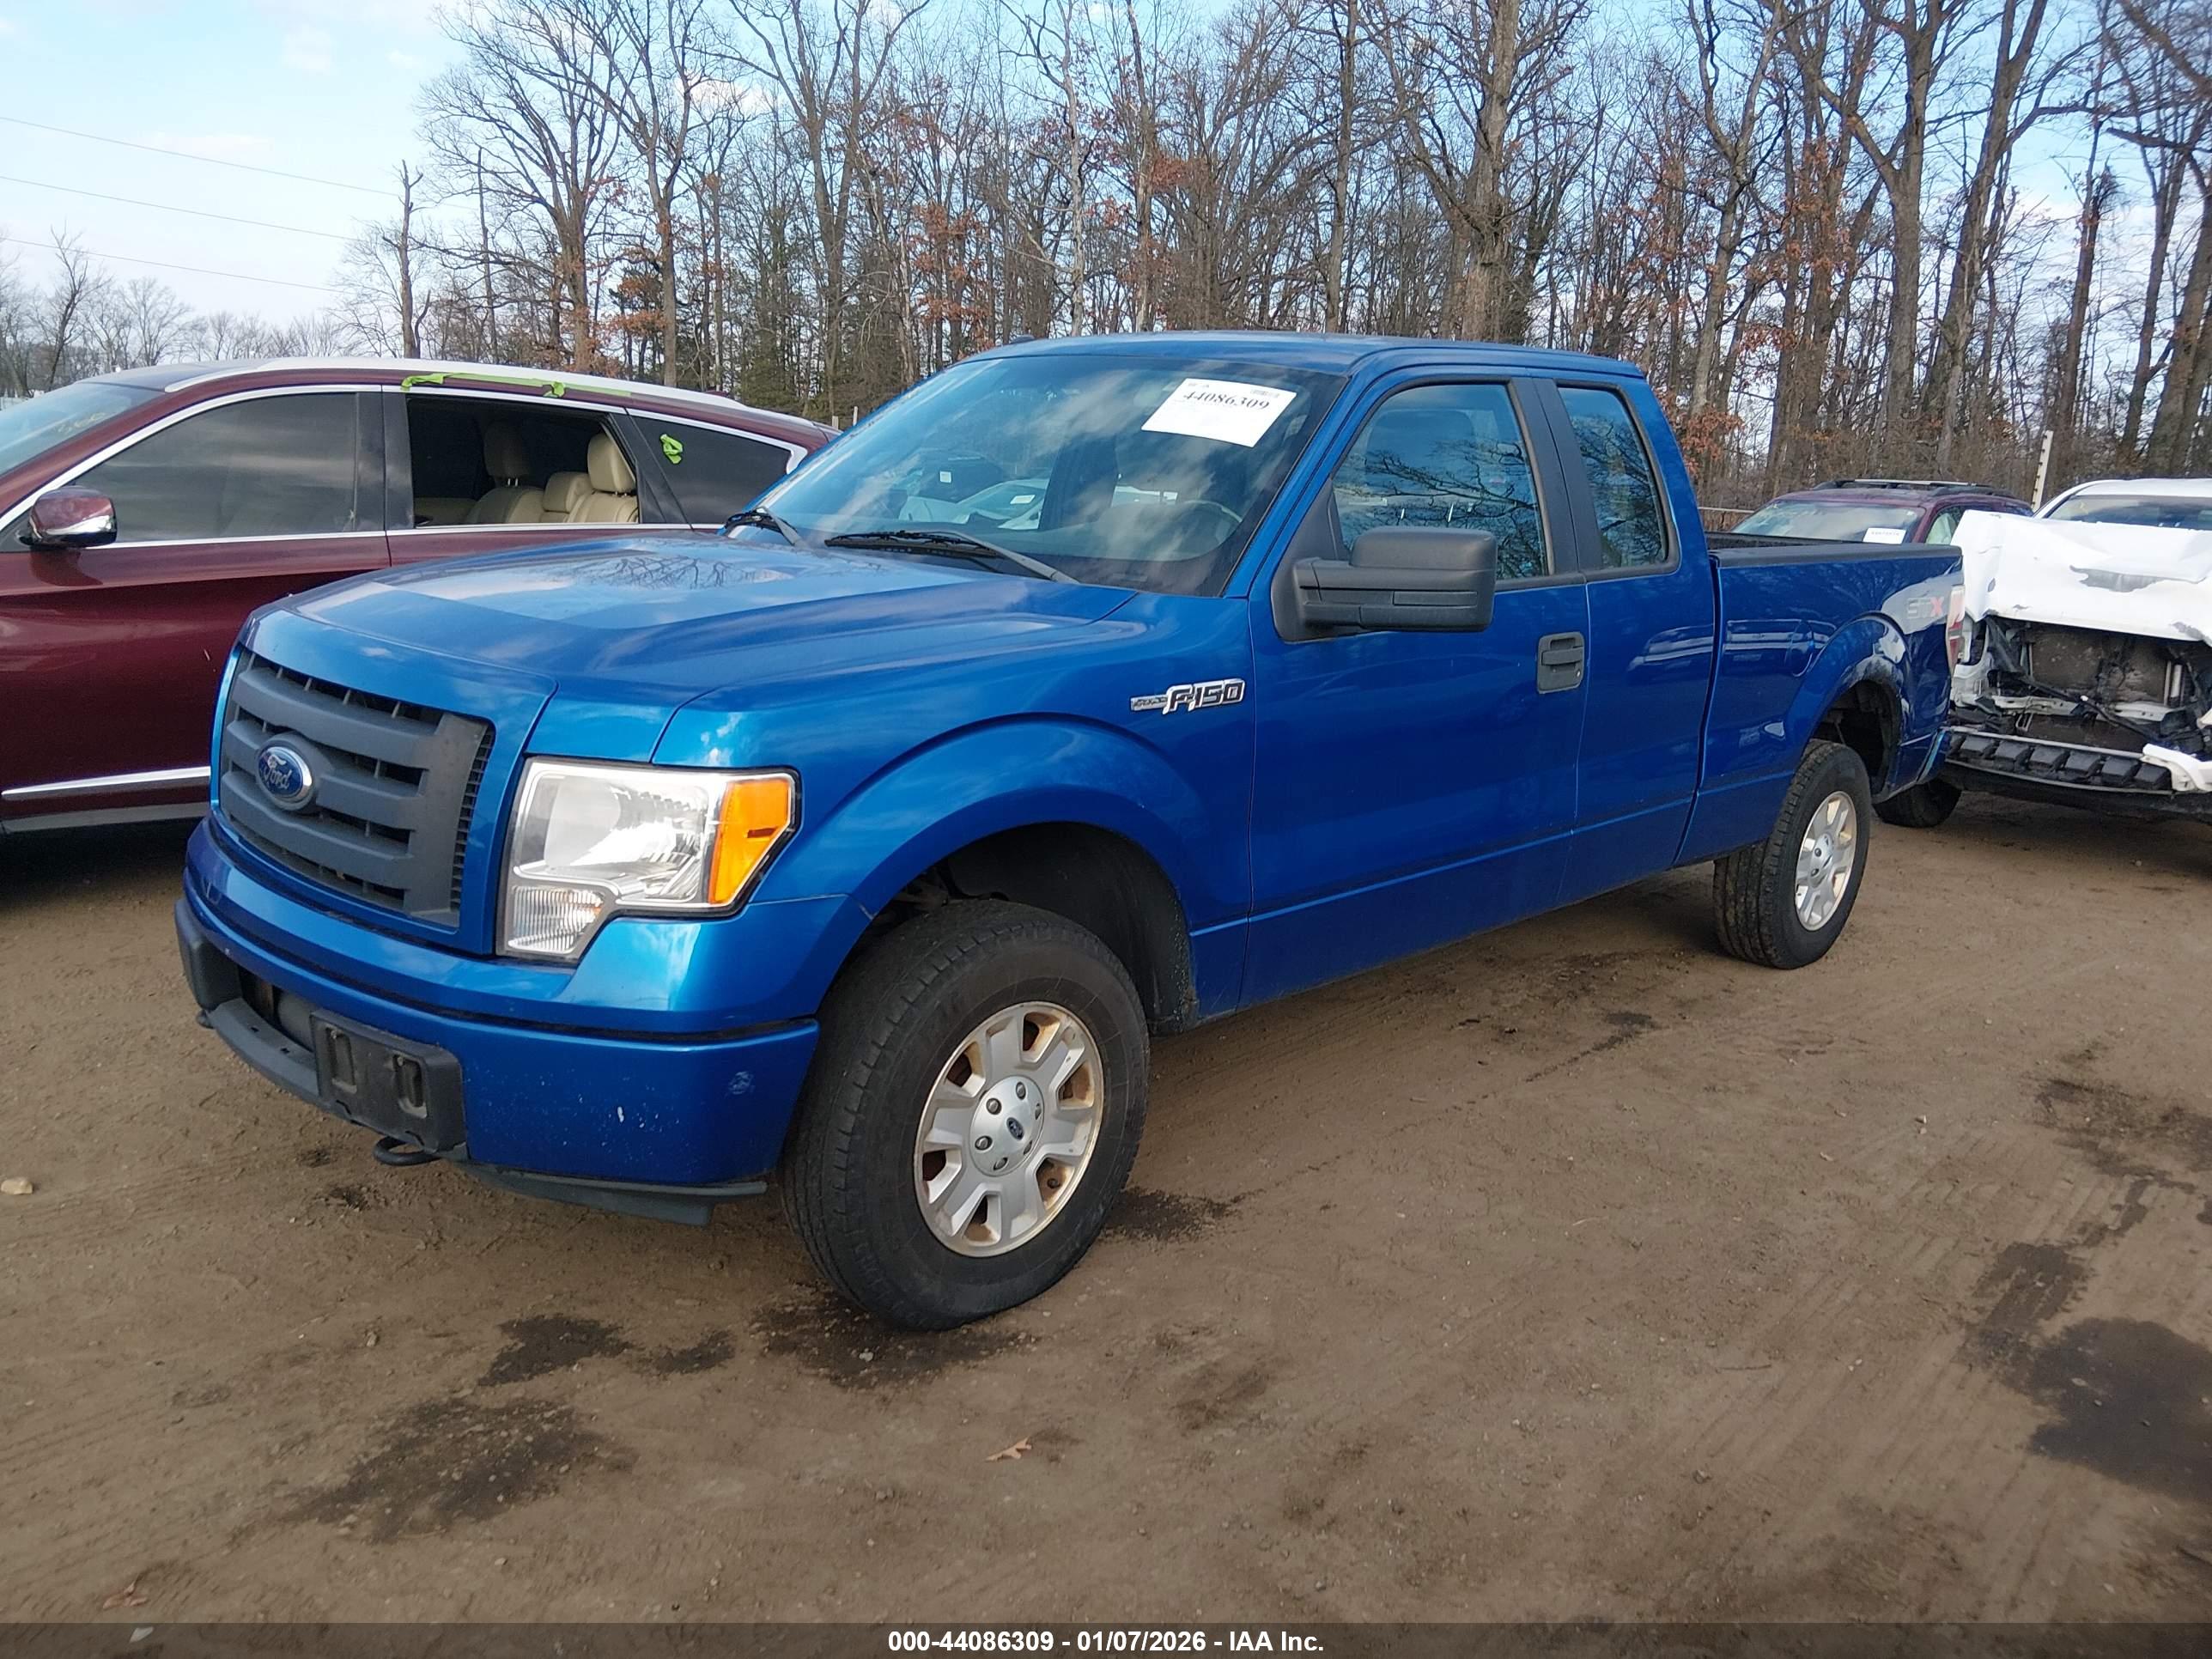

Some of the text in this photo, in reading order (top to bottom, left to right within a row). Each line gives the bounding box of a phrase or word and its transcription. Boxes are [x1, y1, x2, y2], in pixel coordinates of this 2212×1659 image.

[1183, 391, 1270, 410] 44086309
[1906, 597, 1945, 618] STX
[259, 755, 293, 789] Ford
